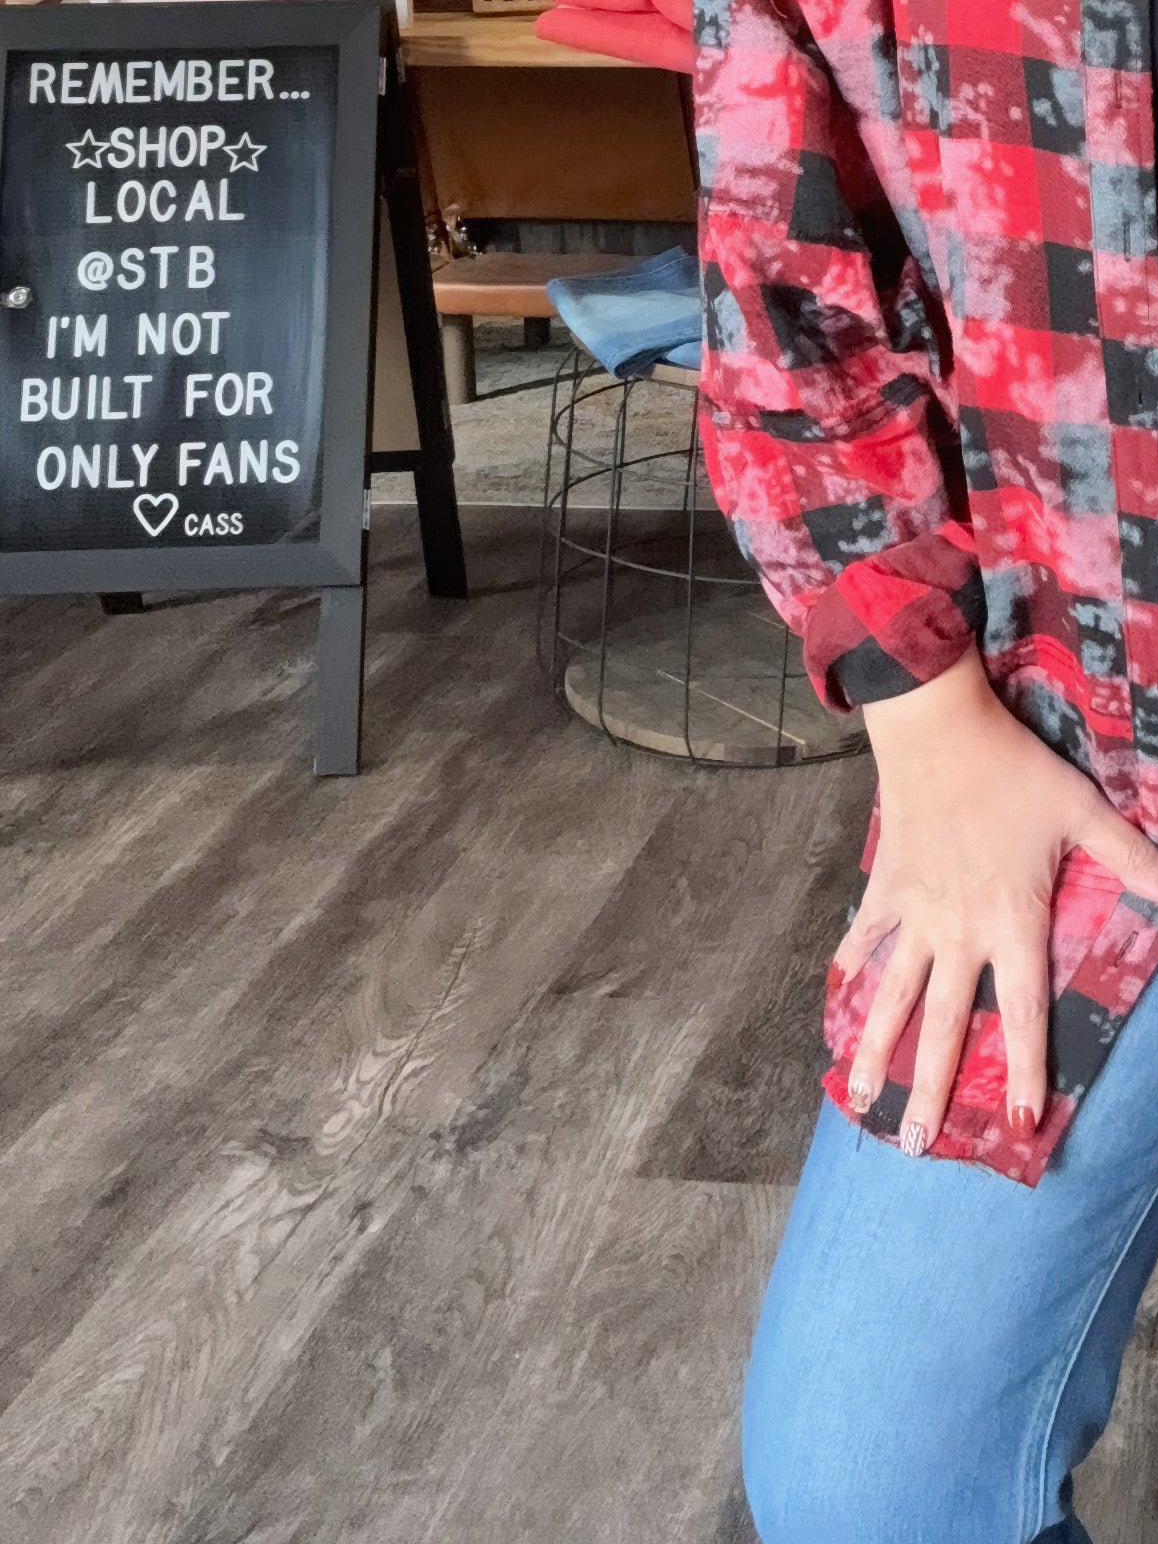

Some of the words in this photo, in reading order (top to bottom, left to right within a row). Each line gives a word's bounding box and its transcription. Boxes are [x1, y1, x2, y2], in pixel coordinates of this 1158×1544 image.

[29, 58, 310, 105] REMEMBER...
[107, 125, 226, 169] SHOP
[85, 178, 245, 223] LOCAL
[77, 245, 216, 291] @STB
[46, 314, 108, 359] I'M
[137, 311, 231, 356] NOT
[20, 374, 153, 422] BUILT
[184, 371, 274, 418] FOR
[37, 443, 159, 490] ONLY
[178, 439, 300, 486] FANS
[184, 512, 244, 536] CASS
